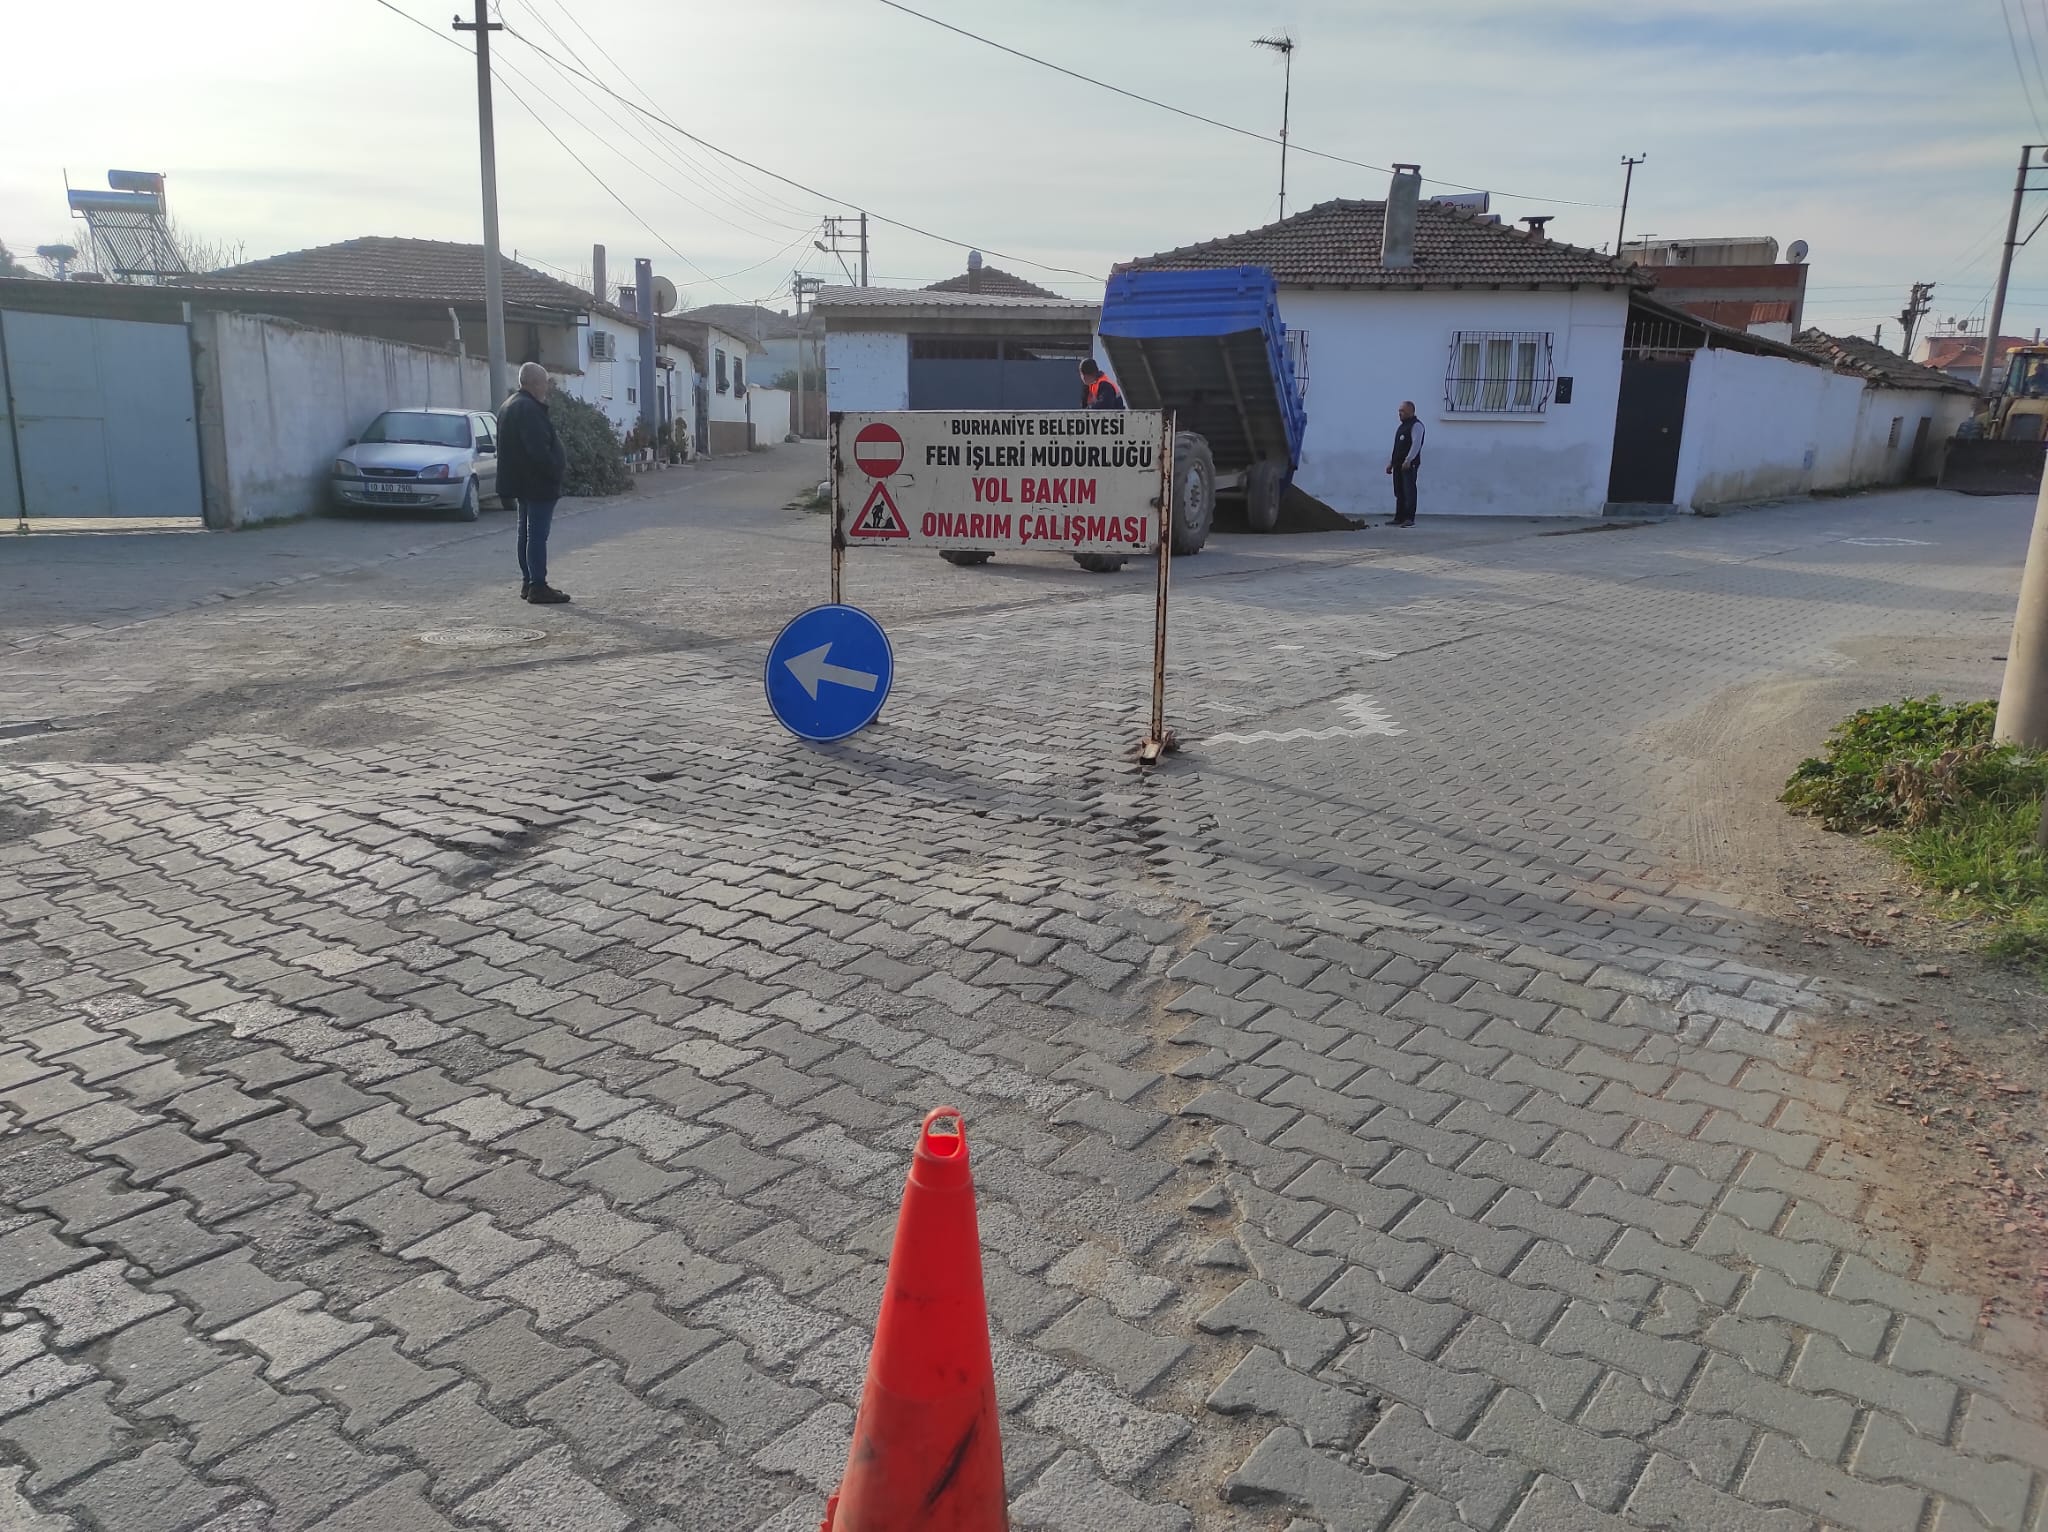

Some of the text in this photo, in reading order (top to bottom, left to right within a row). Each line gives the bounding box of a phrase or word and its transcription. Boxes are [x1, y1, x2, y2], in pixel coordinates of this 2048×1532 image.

[951, 414, 1125, 436] BURHANİYE BELEDİYESİ
[926, 440, 1152, 471] FEN İŞLERİ MÜDÜRLÜĞÜ
[972, 477, 1097, 505] YOL BAKIM
[922, 512, 1147, 546] ONARIM ÇALIŞMASI
